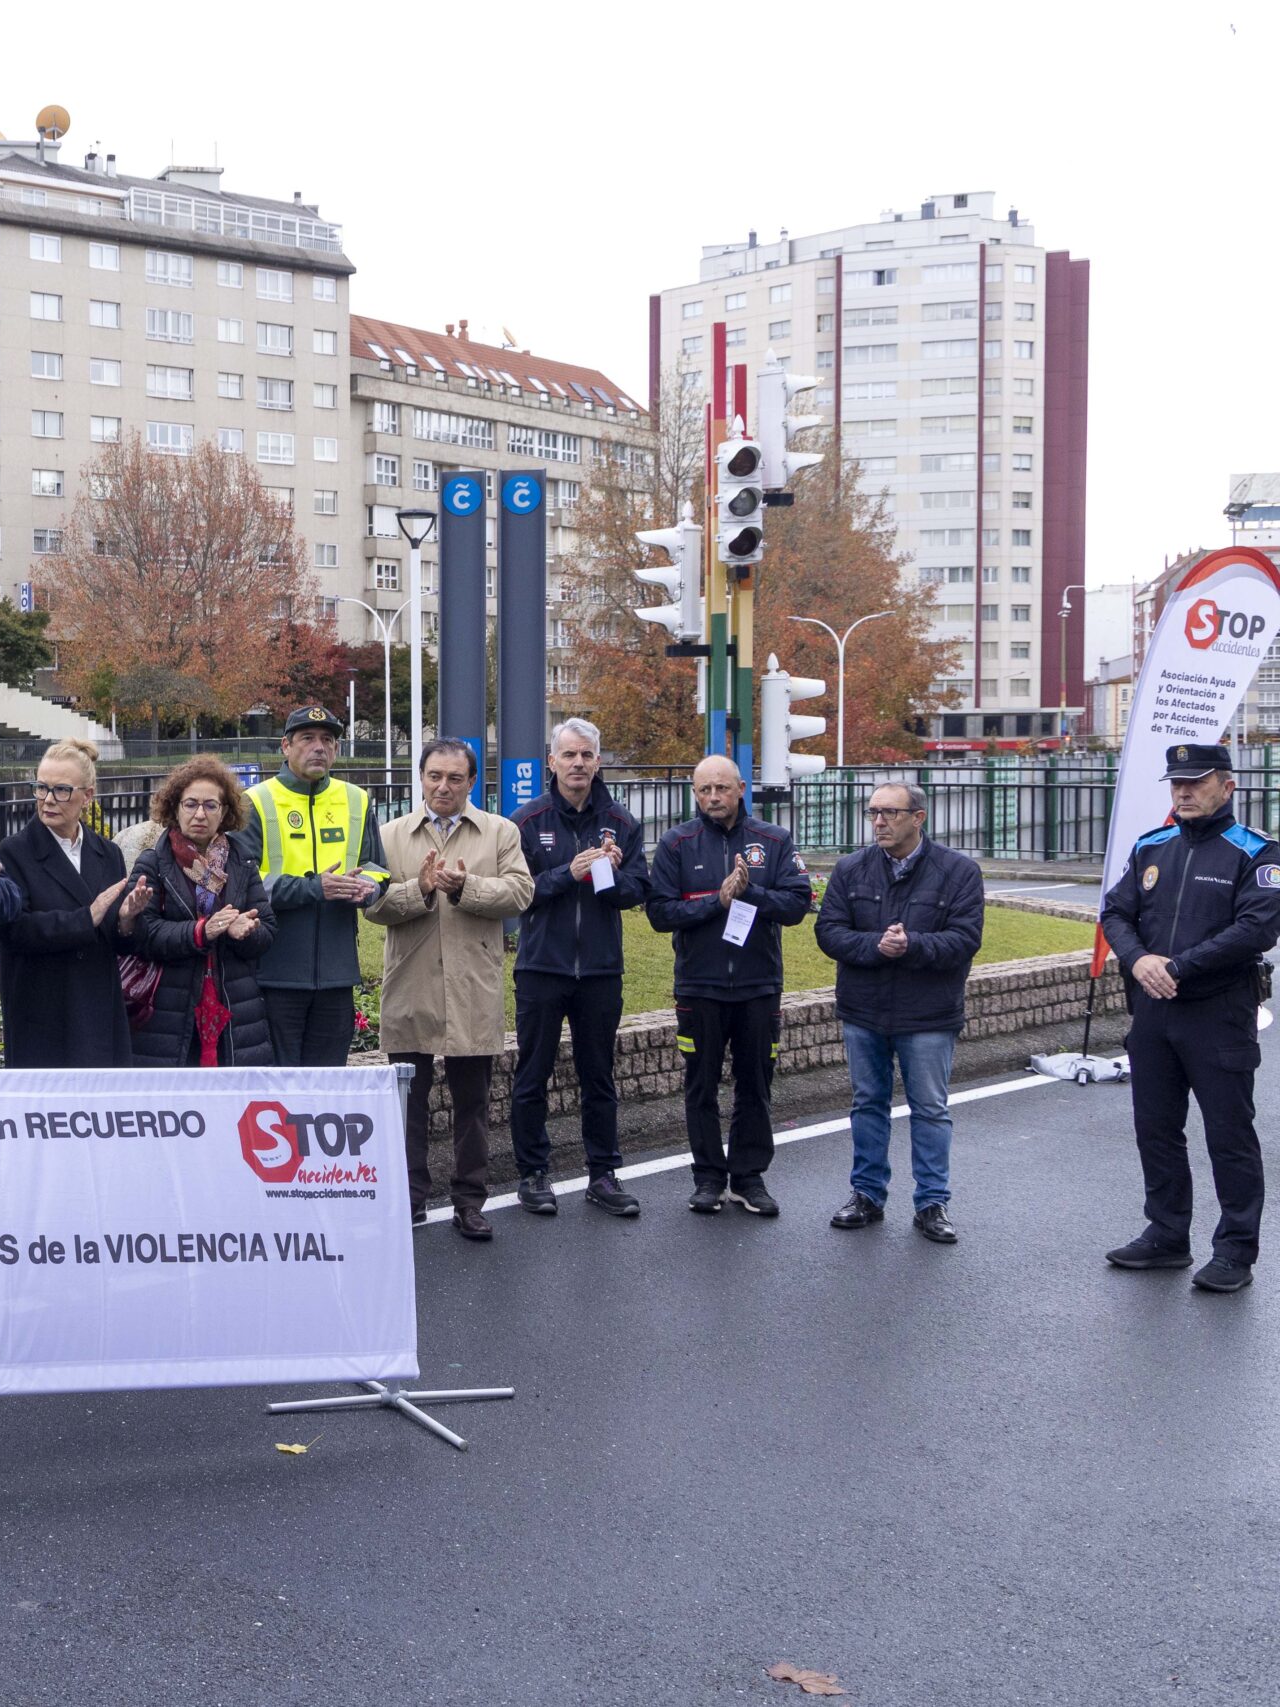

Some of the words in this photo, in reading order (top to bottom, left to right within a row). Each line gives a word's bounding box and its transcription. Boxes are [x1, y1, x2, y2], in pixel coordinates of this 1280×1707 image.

[1190, 604, 1266, 640] STOP
[1211, 640, 1260, 658] accidentes
[1161, 669, 1208, 684] Asociación
[1210, 676, 1236, 688] Ayuda
[1157, 685, 1163, 693] y
[1166, 684, 1217, 699] Orientación
[1155, 696, 1169, 706] los
[1171, 698, 1216, 712] Afectados
[1153, 711, 1169, 720] por
[1170, 712, 1219, 727] Accidentes
[1151, 724, 1162, 732] de
[1165, 725, 1199, 737] Tráfico.
[24, 1110, 206, 1140] RECUERDO
[251, 1108, 374, 1169] STOP
[297, 1160, 378, 1186] accidentes
[265, 1188, 376, 1200] www.stopaccidentes.org
[28, 1234, 66, 1265] de
[74, 1234, 101, 1264] la
[104, 1232, 269, 1263] VIOLENCIA
[273, 1232, 345, 1262] VIAL.
